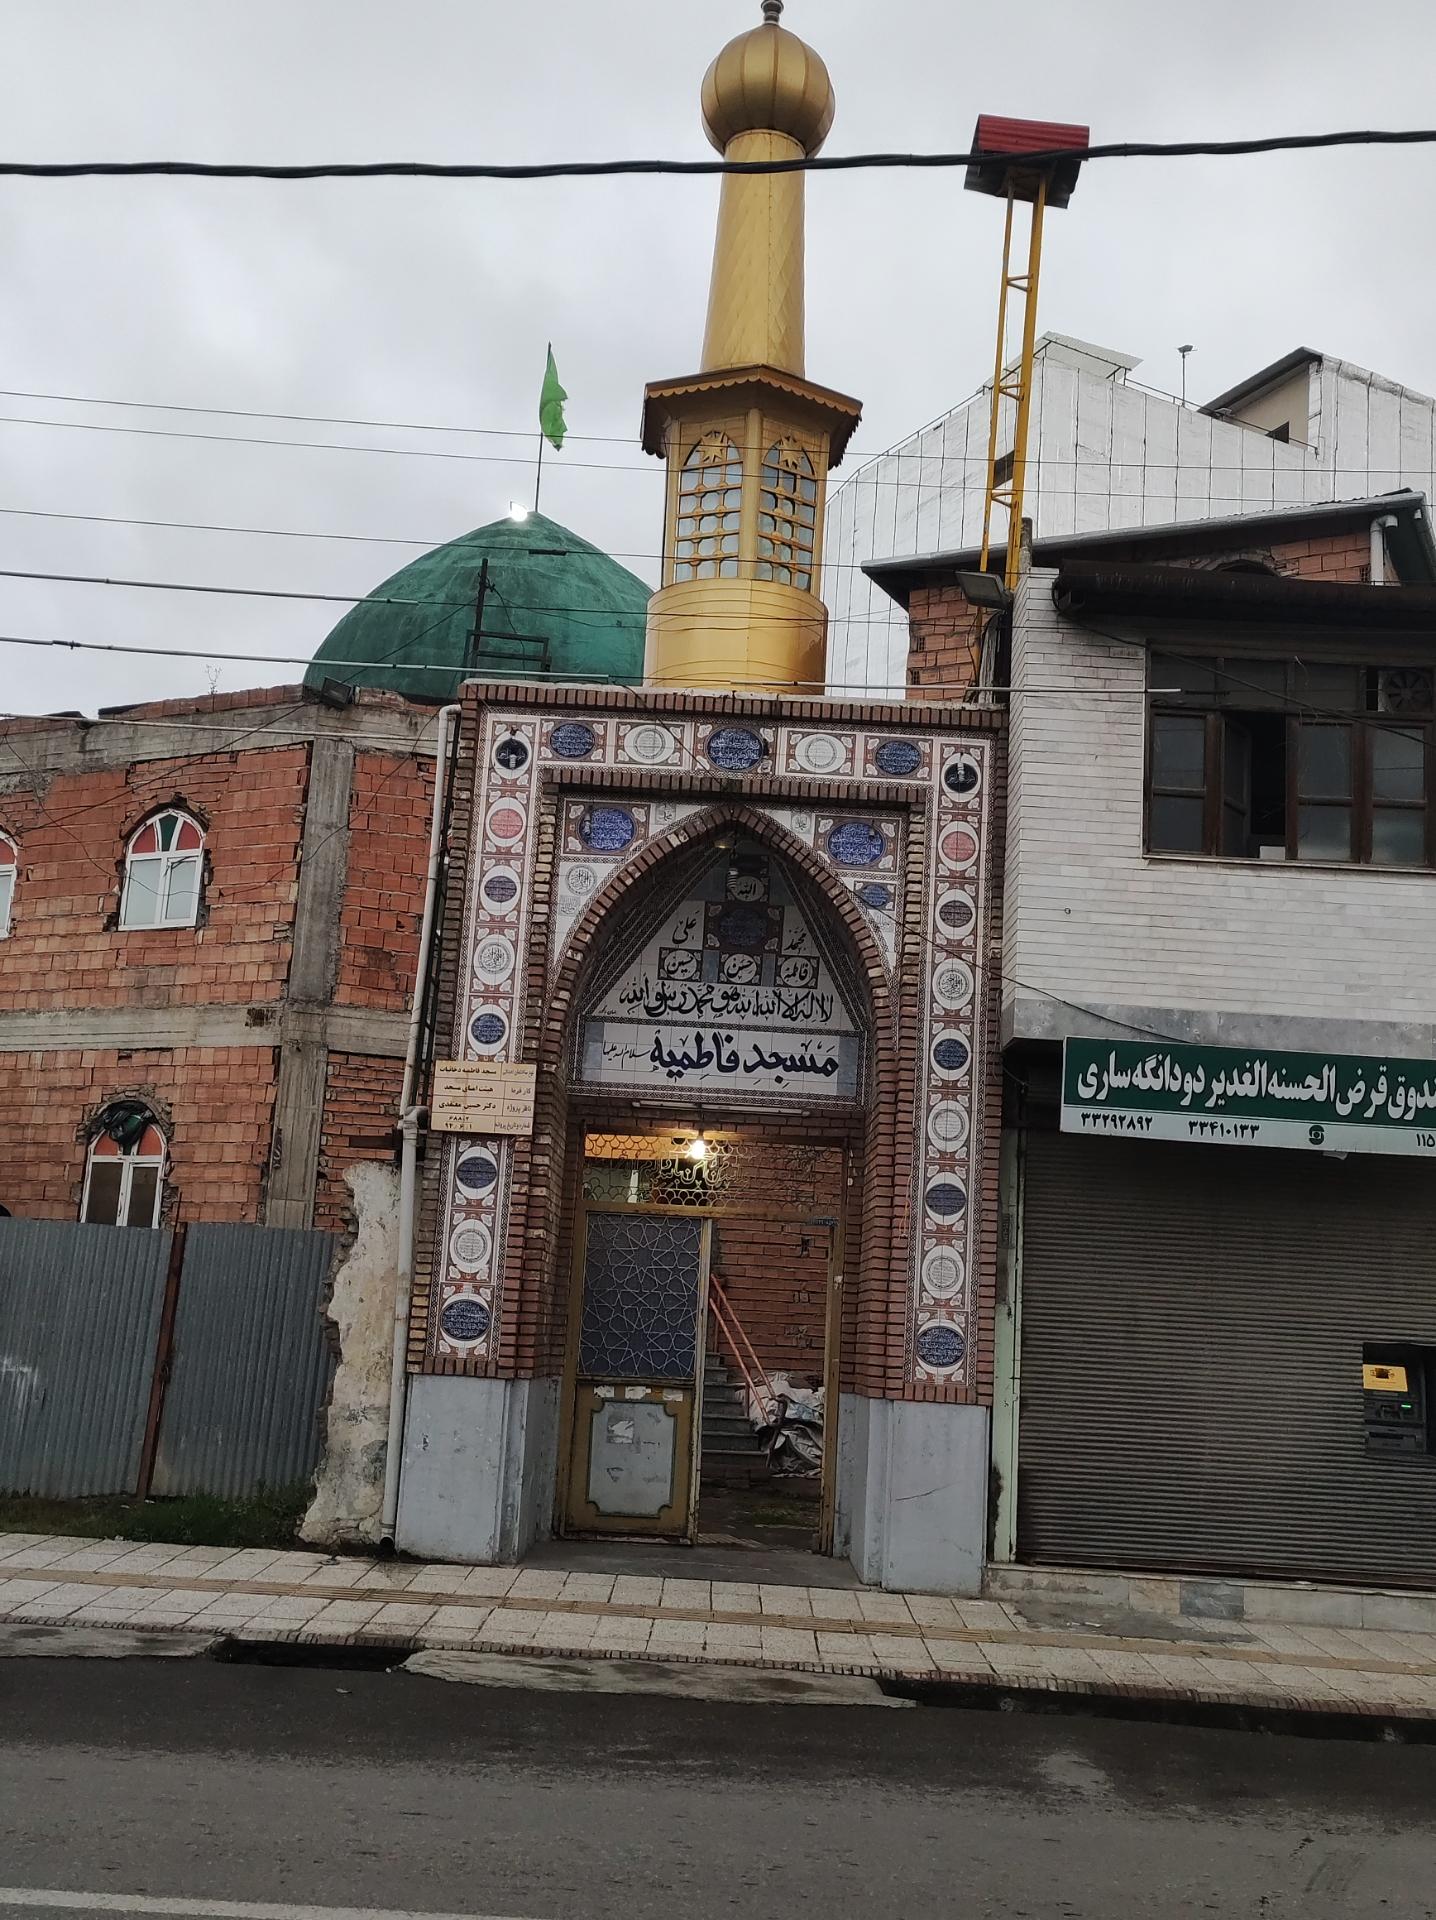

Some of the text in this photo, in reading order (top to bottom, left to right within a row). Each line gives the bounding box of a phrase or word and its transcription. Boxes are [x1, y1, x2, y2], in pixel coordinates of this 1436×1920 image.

[742, 1042, 839, 1086] مسجد
[1077, 1050, 1133, 1100] ساری
[1204, 1058, 1268, 1108] الغدیر
[1266, 1062, 1337, 1103] الحسنه
[1335, 1064, 1388, 1118] قرض
[1080, 1111, 1153, 1131] ۳۳۲۹۲۸۹۲
[1188, 1119, 1260, 1139] ۳۳۴۱۰۱۳۳
